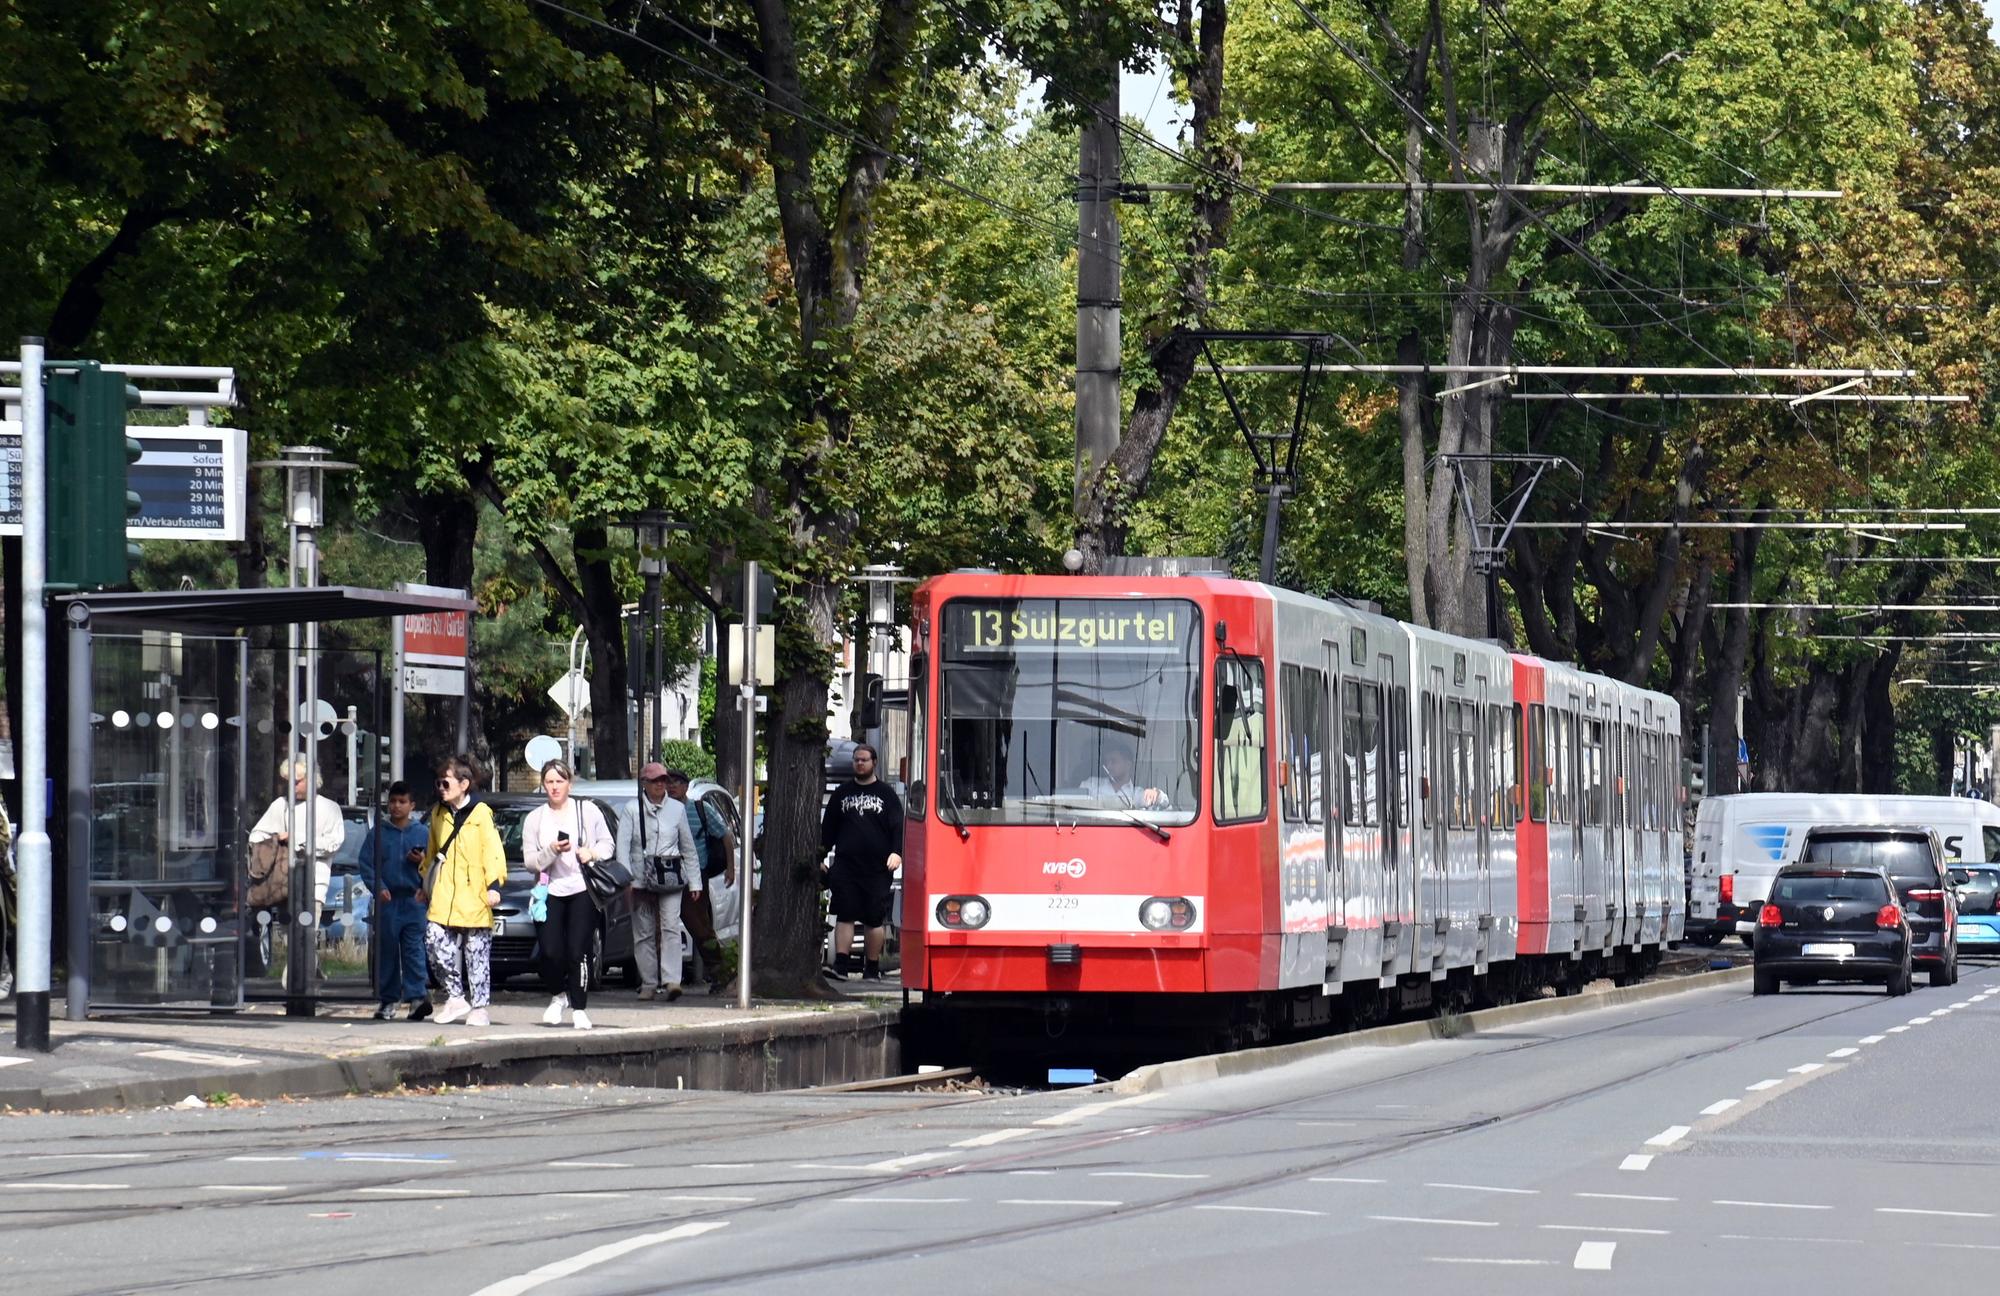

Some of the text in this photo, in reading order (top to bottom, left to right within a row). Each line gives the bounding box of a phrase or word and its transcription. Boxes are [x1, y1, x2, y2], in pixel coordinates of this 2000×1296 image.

[198, 442, 207, 451] in
[192, 455, 223, 465] Sofort
[195, 468, 224, 478] 9 Min
[189, 480, 224, 490] 20 Min
[190, 493, 224, 503] 29 Min
[190, 506, 224, 515] 38 Min
[971, 609, 1175, 648] 13 Sülzgürtel
[1042, 862, 1067, 874] KVB
[1048, 897, 1079, 909] 2229
